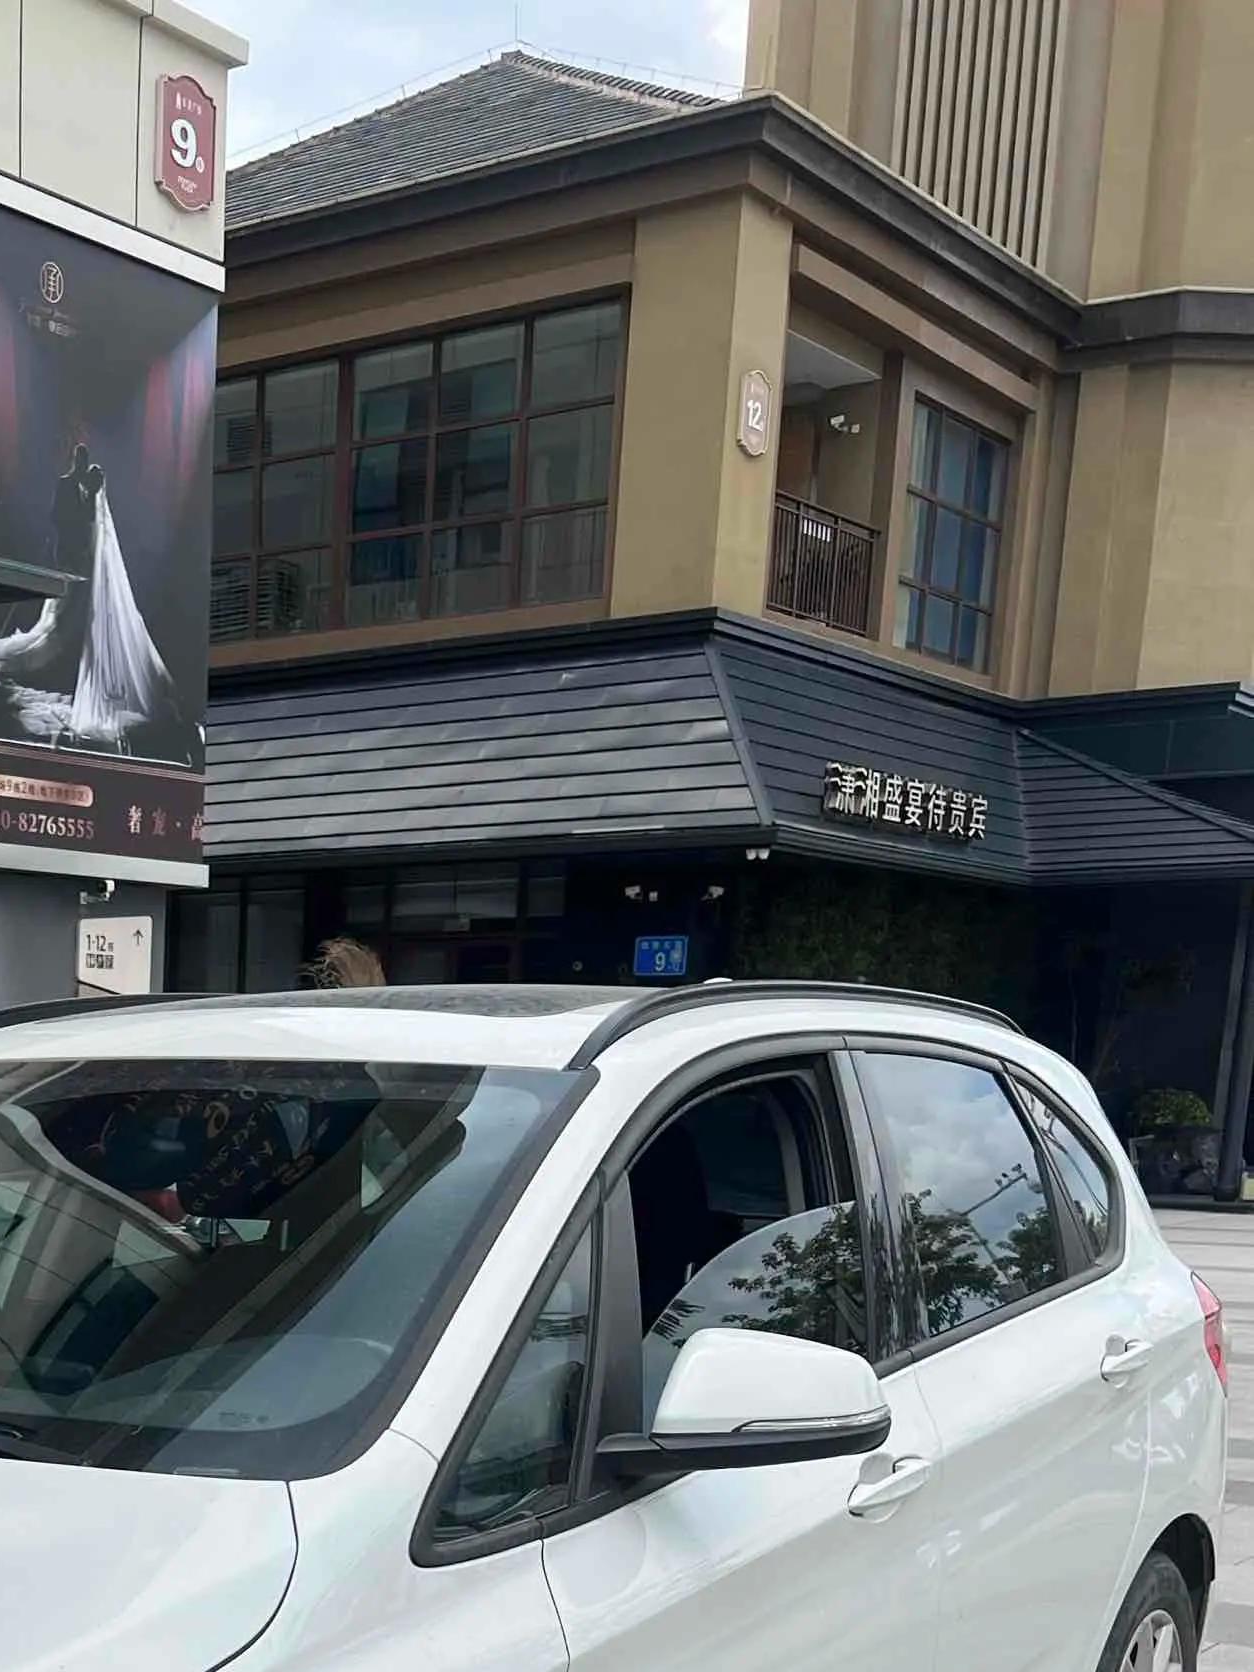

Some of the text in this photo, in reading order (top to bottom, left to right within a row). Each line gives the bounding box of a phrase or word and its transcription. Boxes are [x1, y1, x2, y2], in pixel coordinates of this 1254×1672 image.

[171, 118, 197, 168] 9
[747, 399, 764, 433] 12
[825, 760, 989, 840] 潇湘盛宴待贵宾
